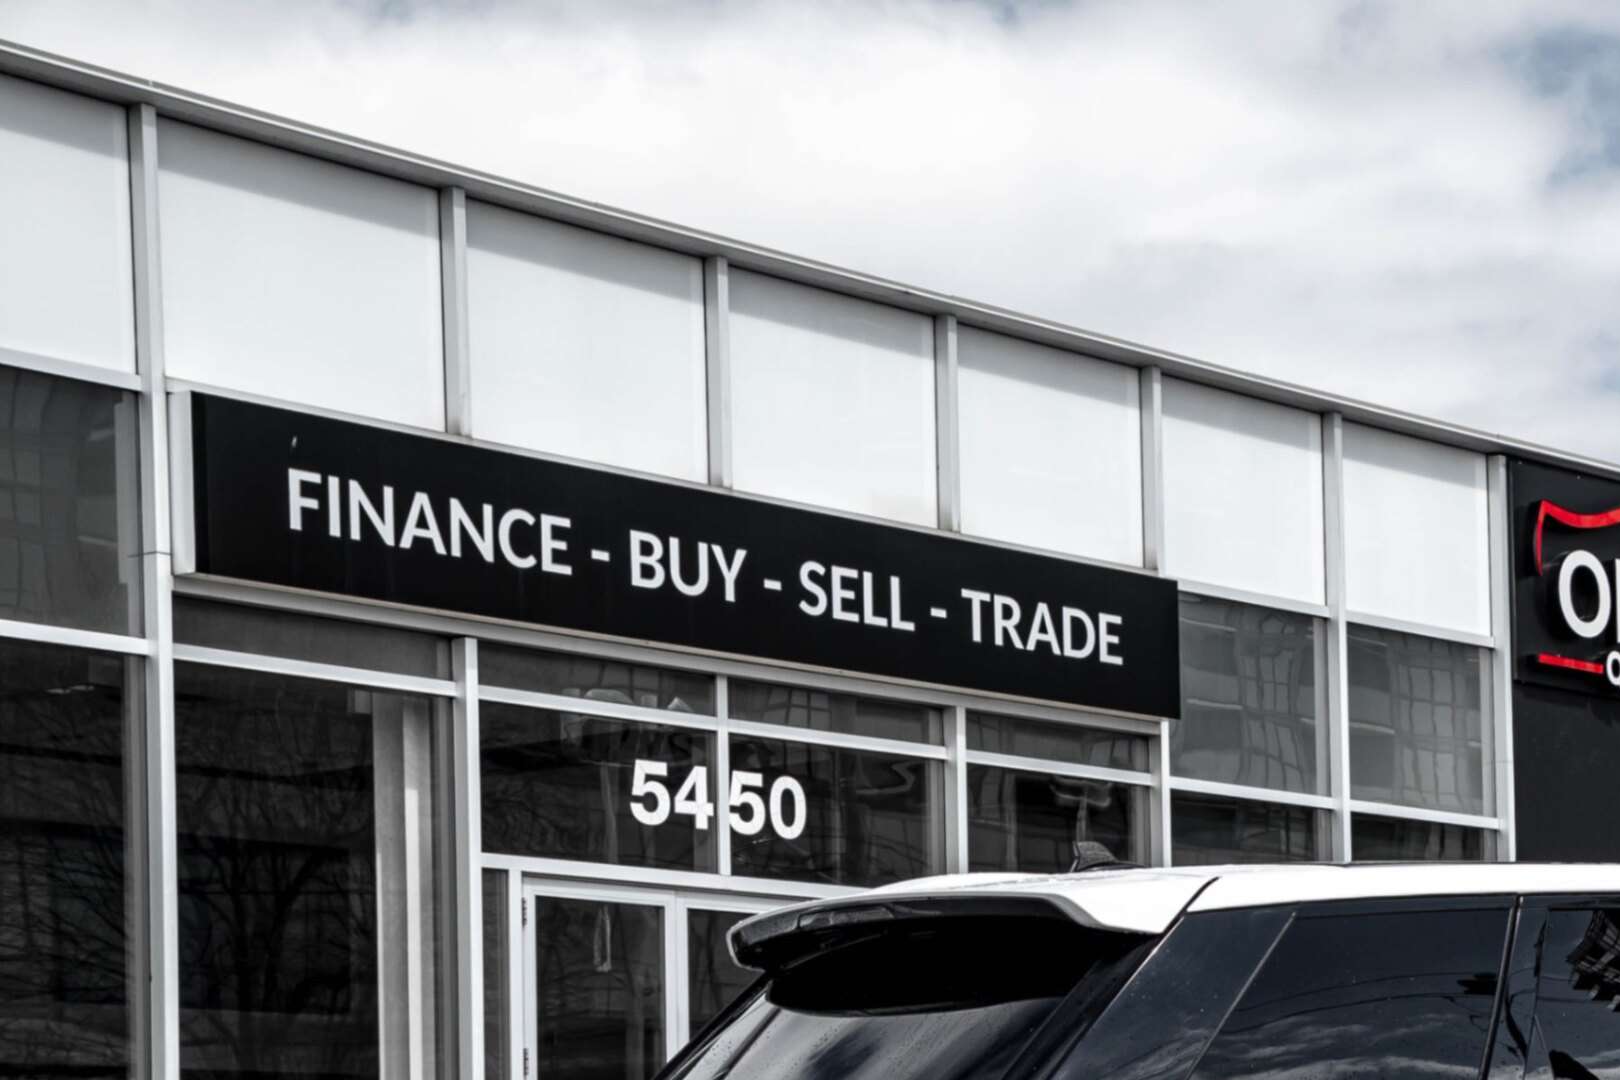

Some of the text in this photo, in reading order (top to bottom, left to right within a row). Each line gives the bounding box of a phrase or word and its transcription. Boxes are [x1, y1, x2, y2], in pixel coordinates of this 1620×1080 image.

[288, 467, 573, 576] FINANCE
[629, 529, 747, 603] BUY
[799, 560, 915, 632] SELL
[960, 588, 1123, 666] TRADE
[630, 759, 807, 840] 5450
